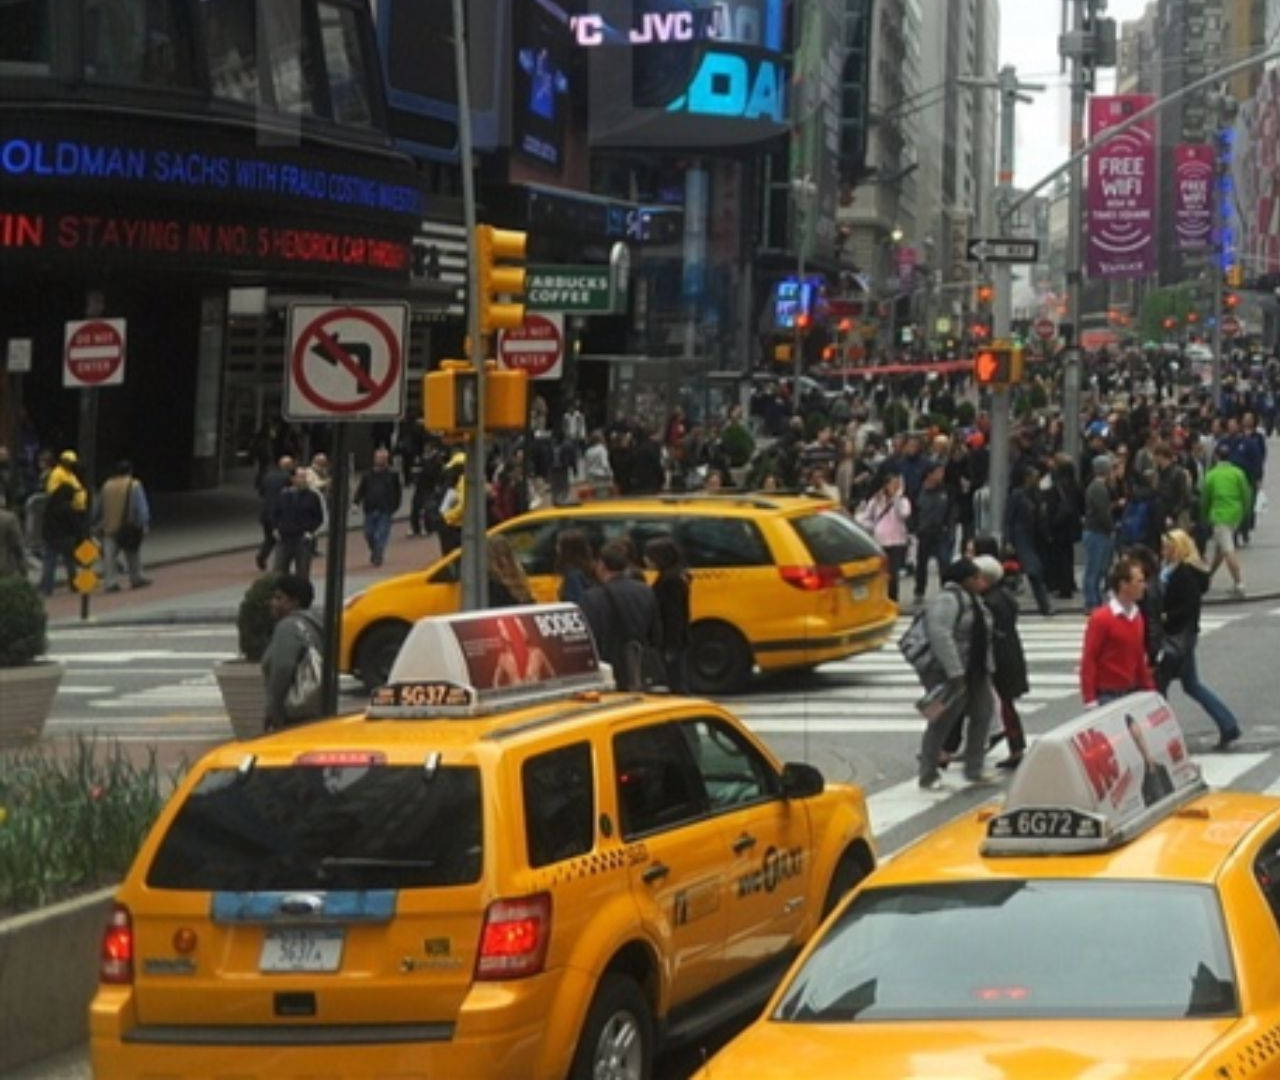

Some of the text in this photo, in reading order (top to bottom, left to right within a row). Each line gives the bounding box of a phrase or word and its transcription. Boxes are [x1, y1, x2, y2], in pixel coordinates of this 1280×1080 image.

[629, 11, 692, 44] JVC
[154, 151, 229, 188] SACHS
[235, 158, 276, 191] WITH
[1098, 157, 1145, 176] FREE
[1101, 178, 1143, 198] WIFI
[58, 216, 179, 253] STAYING
[188, 223, 210, 253] IN
[526, 275, 608, 290] ARBUCKS
[528, 288, 590, 304] COFFEE
[94, 330, 114, 344] NOT
[77, 359, 111, 373] ENTER
[1016, 812, 1073, 835] 6G72
